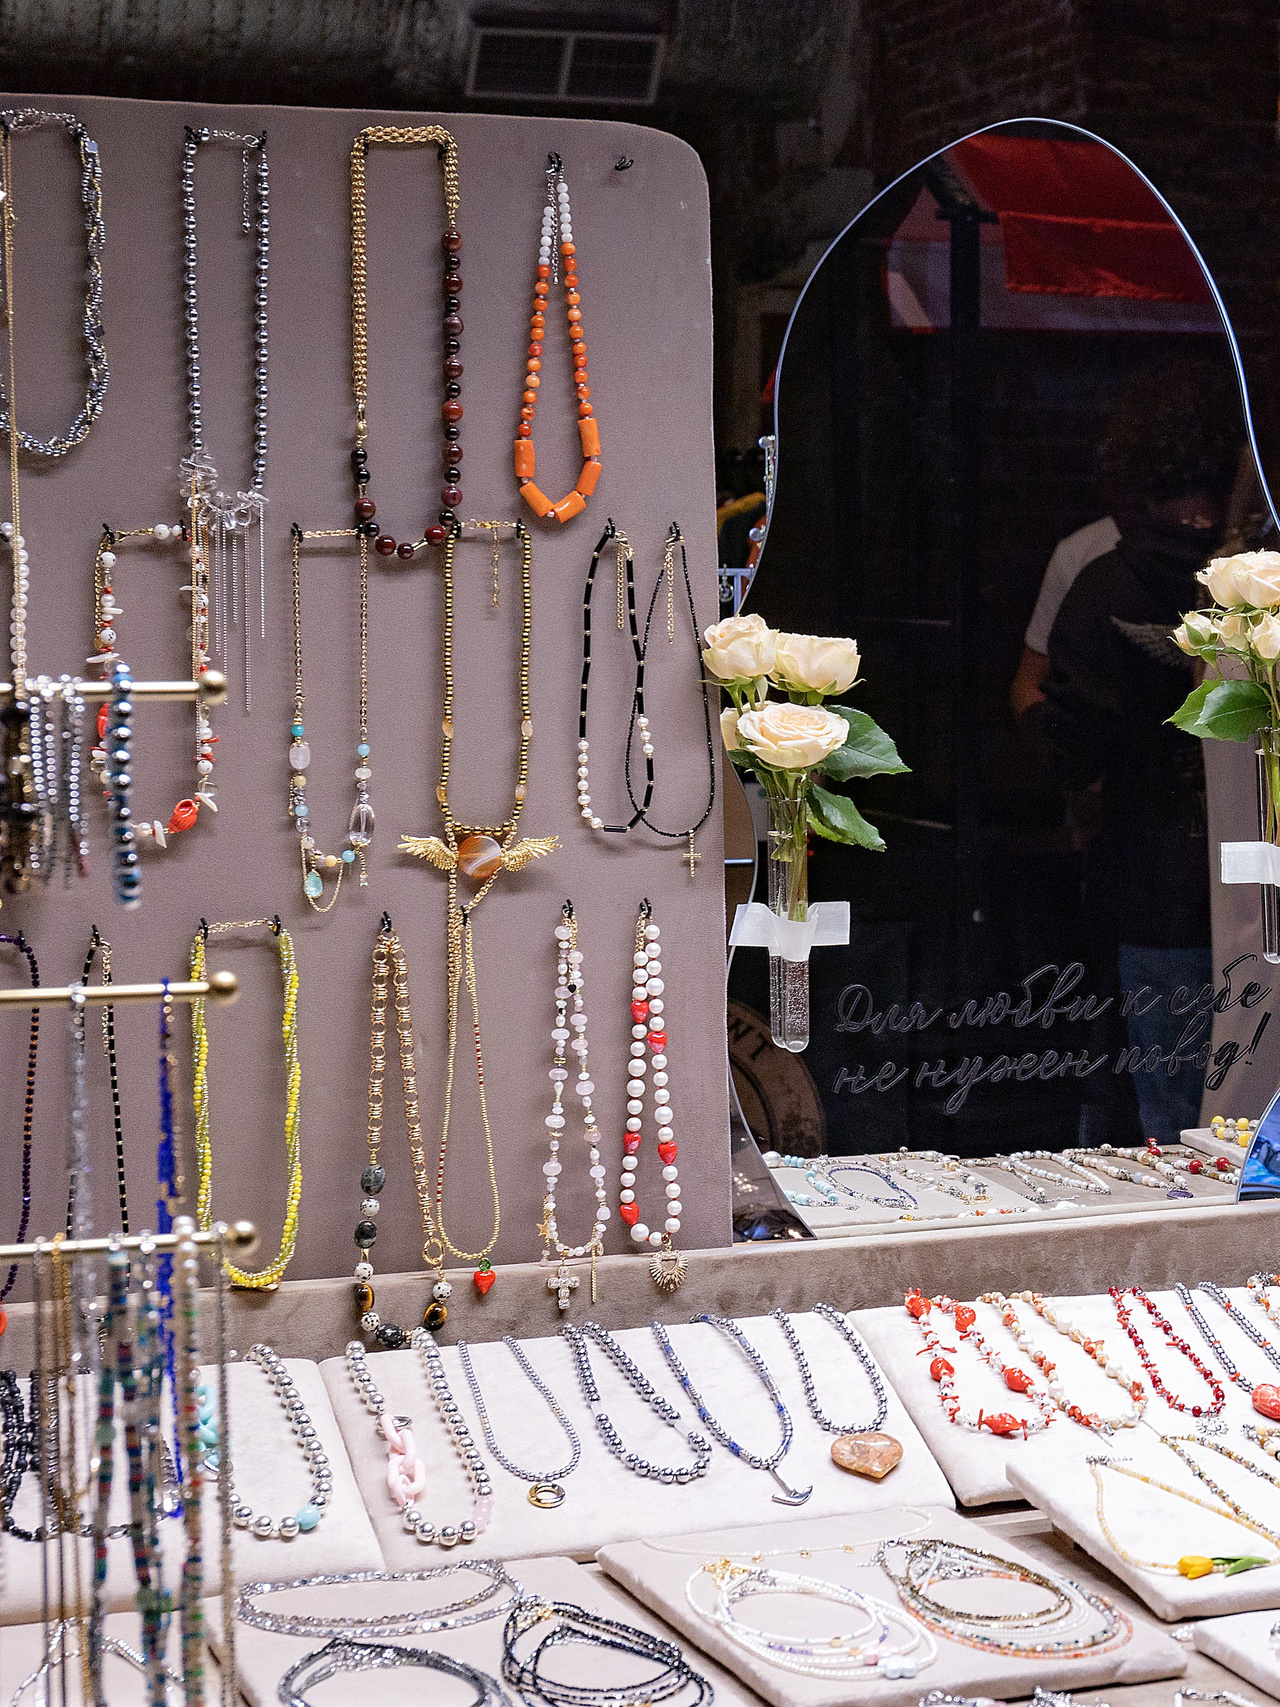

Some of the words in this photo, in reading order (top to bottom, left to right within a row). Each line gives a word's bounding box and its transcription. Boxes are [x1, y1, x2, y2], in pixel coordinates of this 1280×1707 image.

[834, 984, 943, 1034] Для
[947, 962, 1114, 1029] любви
[1119, 985, 1162, 1016] к
[1167, 953, 1273, 1013] себе
[832, 1061, 909, 1093] не
[914, 1050, 1109, 1116] нужен
[1112, 1011, 1271, 1091] повод!
